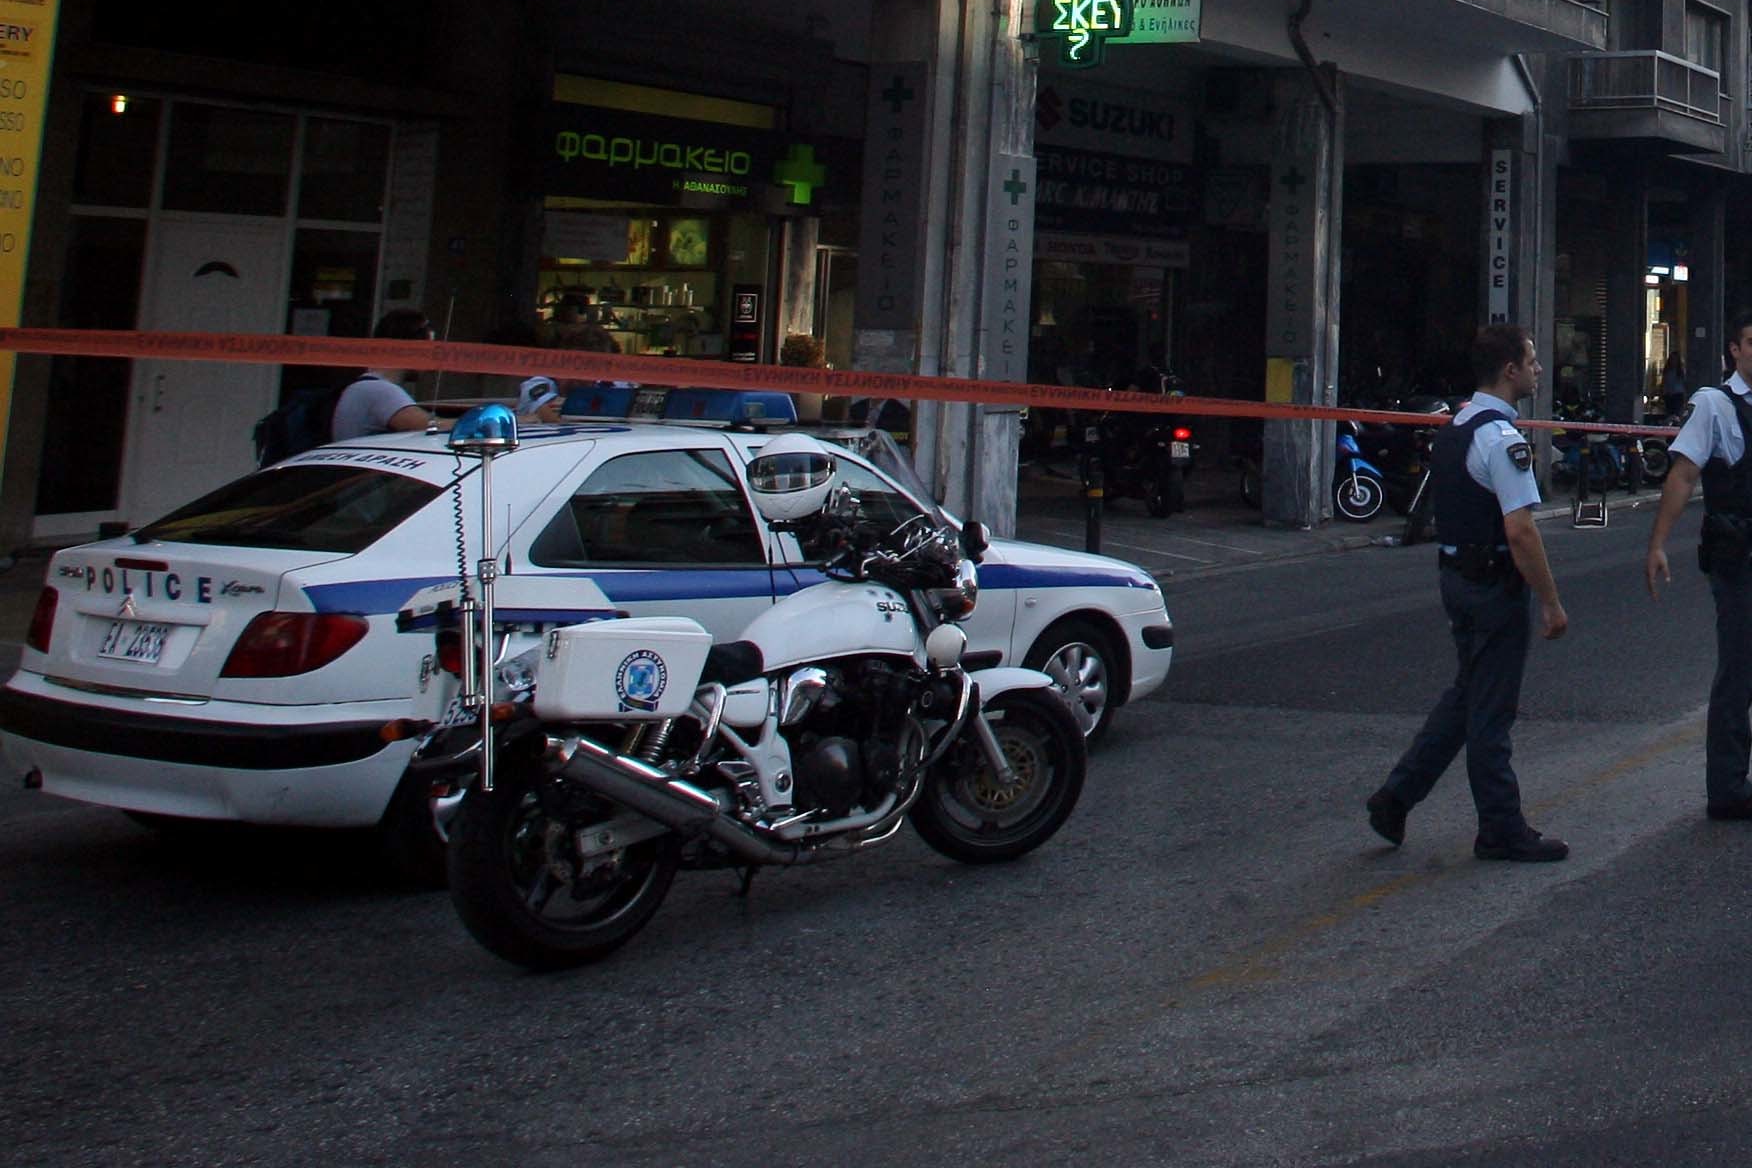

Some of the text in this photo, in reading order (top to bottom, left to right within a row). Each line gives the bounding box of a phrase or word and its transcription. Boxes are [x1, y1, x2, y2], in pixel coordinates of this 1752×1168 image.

[1068, 96, 1176, 140] SUZUKI
[1038, 151, 1118, 181] ERVICE
[877, 126, 904, 313] ΦΑΡΜΑΚΕΙΟ
[1492, 159, 1508, 289] SERVICE
[1001, 218, 1020, 383] ΦΑΡΜΑΚΕΙ
[86, 565, 213, 604] POLICE
